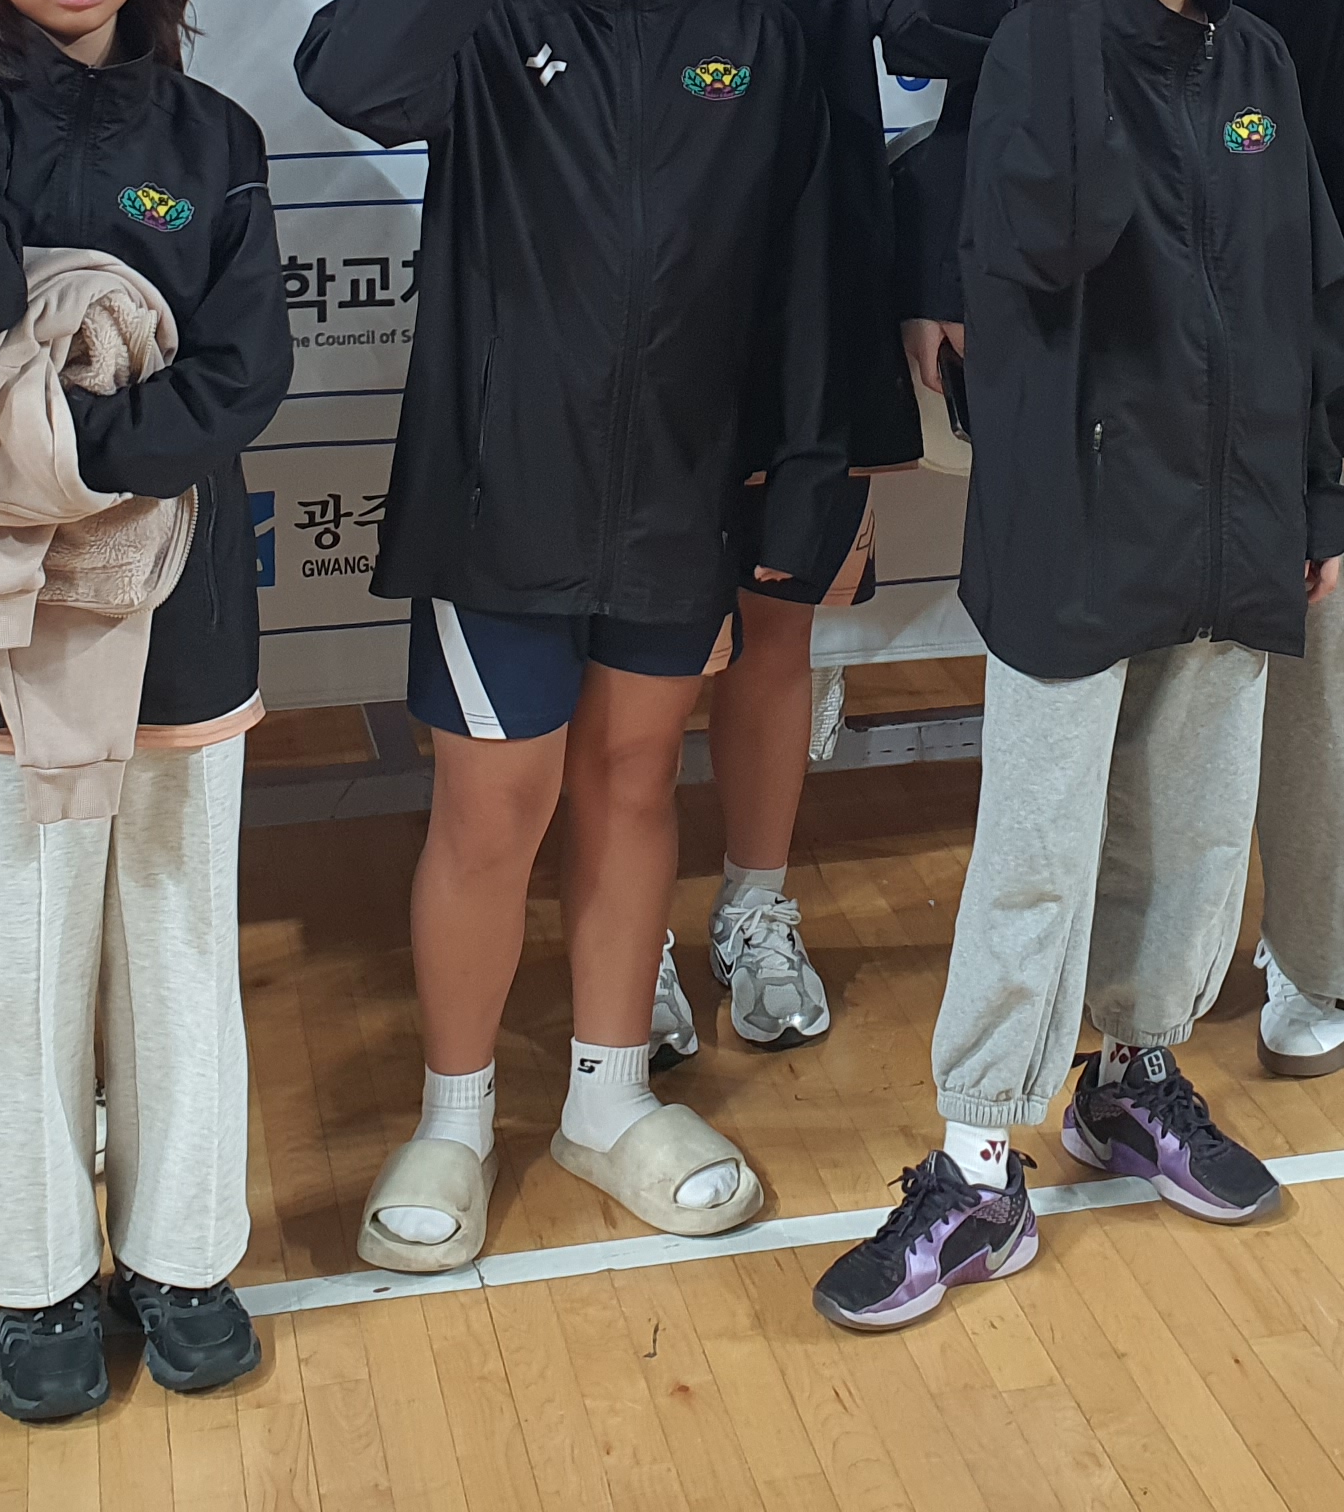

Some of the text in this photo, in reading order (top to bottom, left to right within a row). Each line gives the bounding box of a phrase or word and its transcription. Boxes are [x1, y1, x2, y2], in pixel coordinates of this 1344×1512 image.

[315, 330, 375, 347] Council
[379, 328, 397, 344] of
[401, 328, 414, 344] S
[302, 555, 375, 578] GWANG
